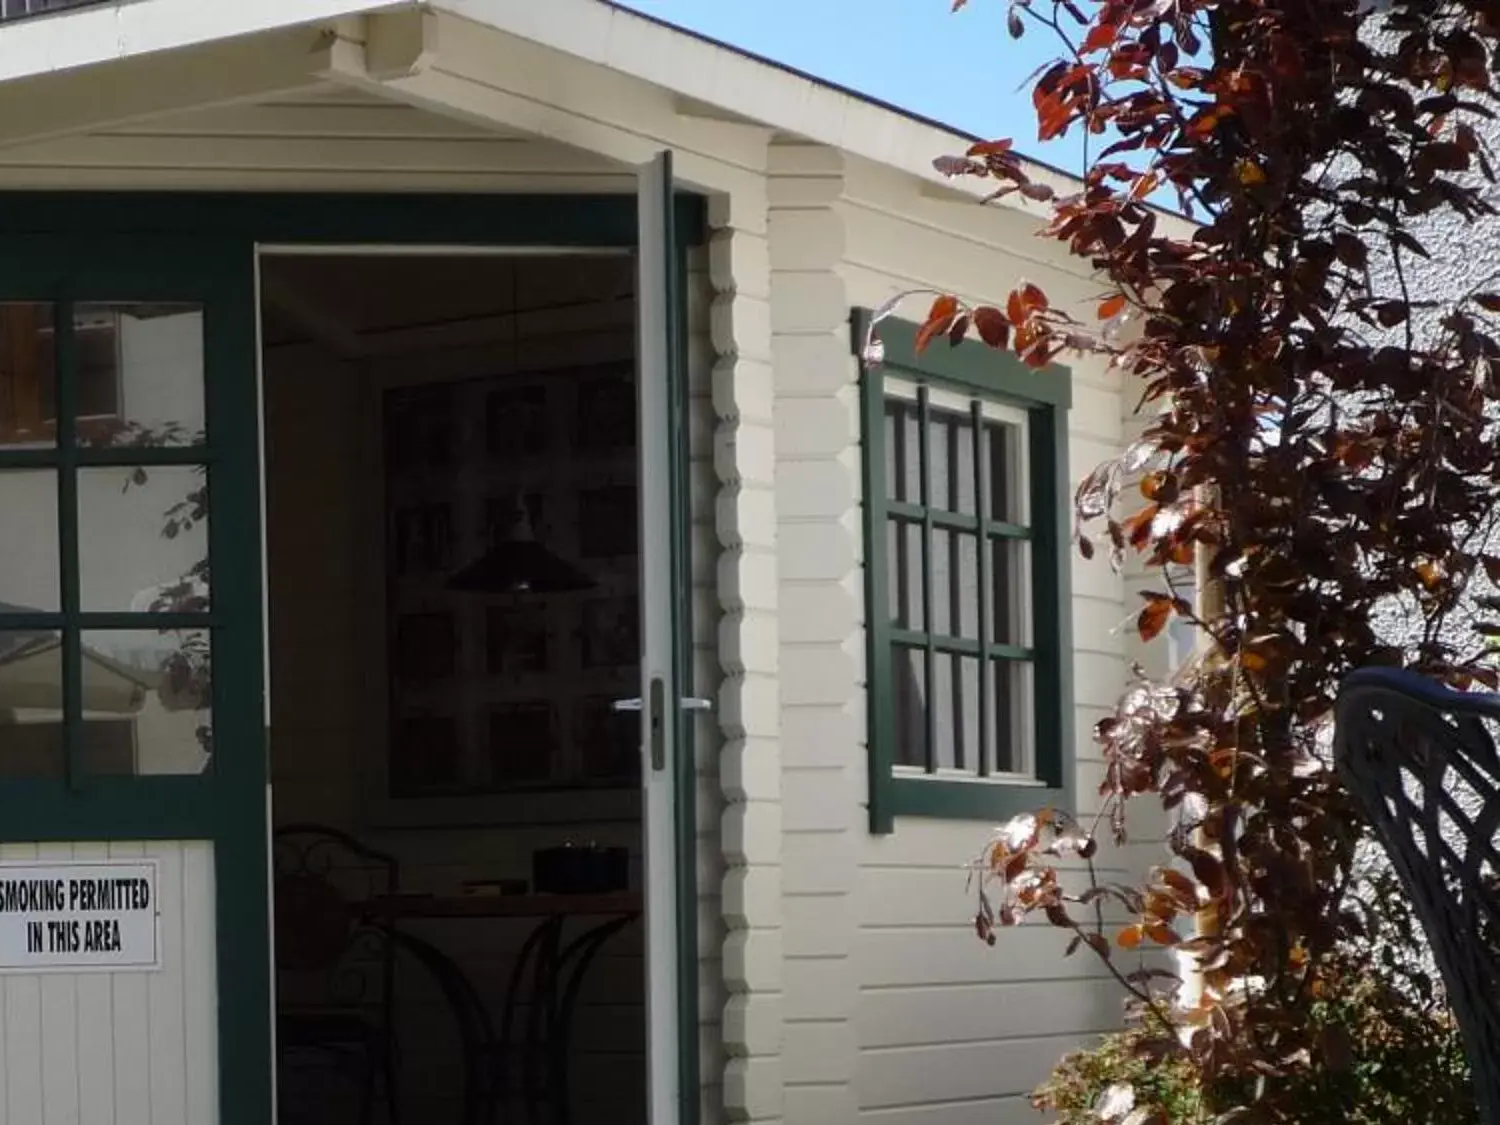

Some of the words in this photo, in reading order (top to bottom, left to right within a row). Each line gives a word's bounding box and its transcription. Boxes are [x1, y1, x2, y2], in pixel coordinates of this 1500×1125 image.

[69, 878, 149, 911] PERMITTED
[27, 921, 43, 953] IN
[48, 920, 79, 952] THIS
[84, 919, 121, 952] AREA
